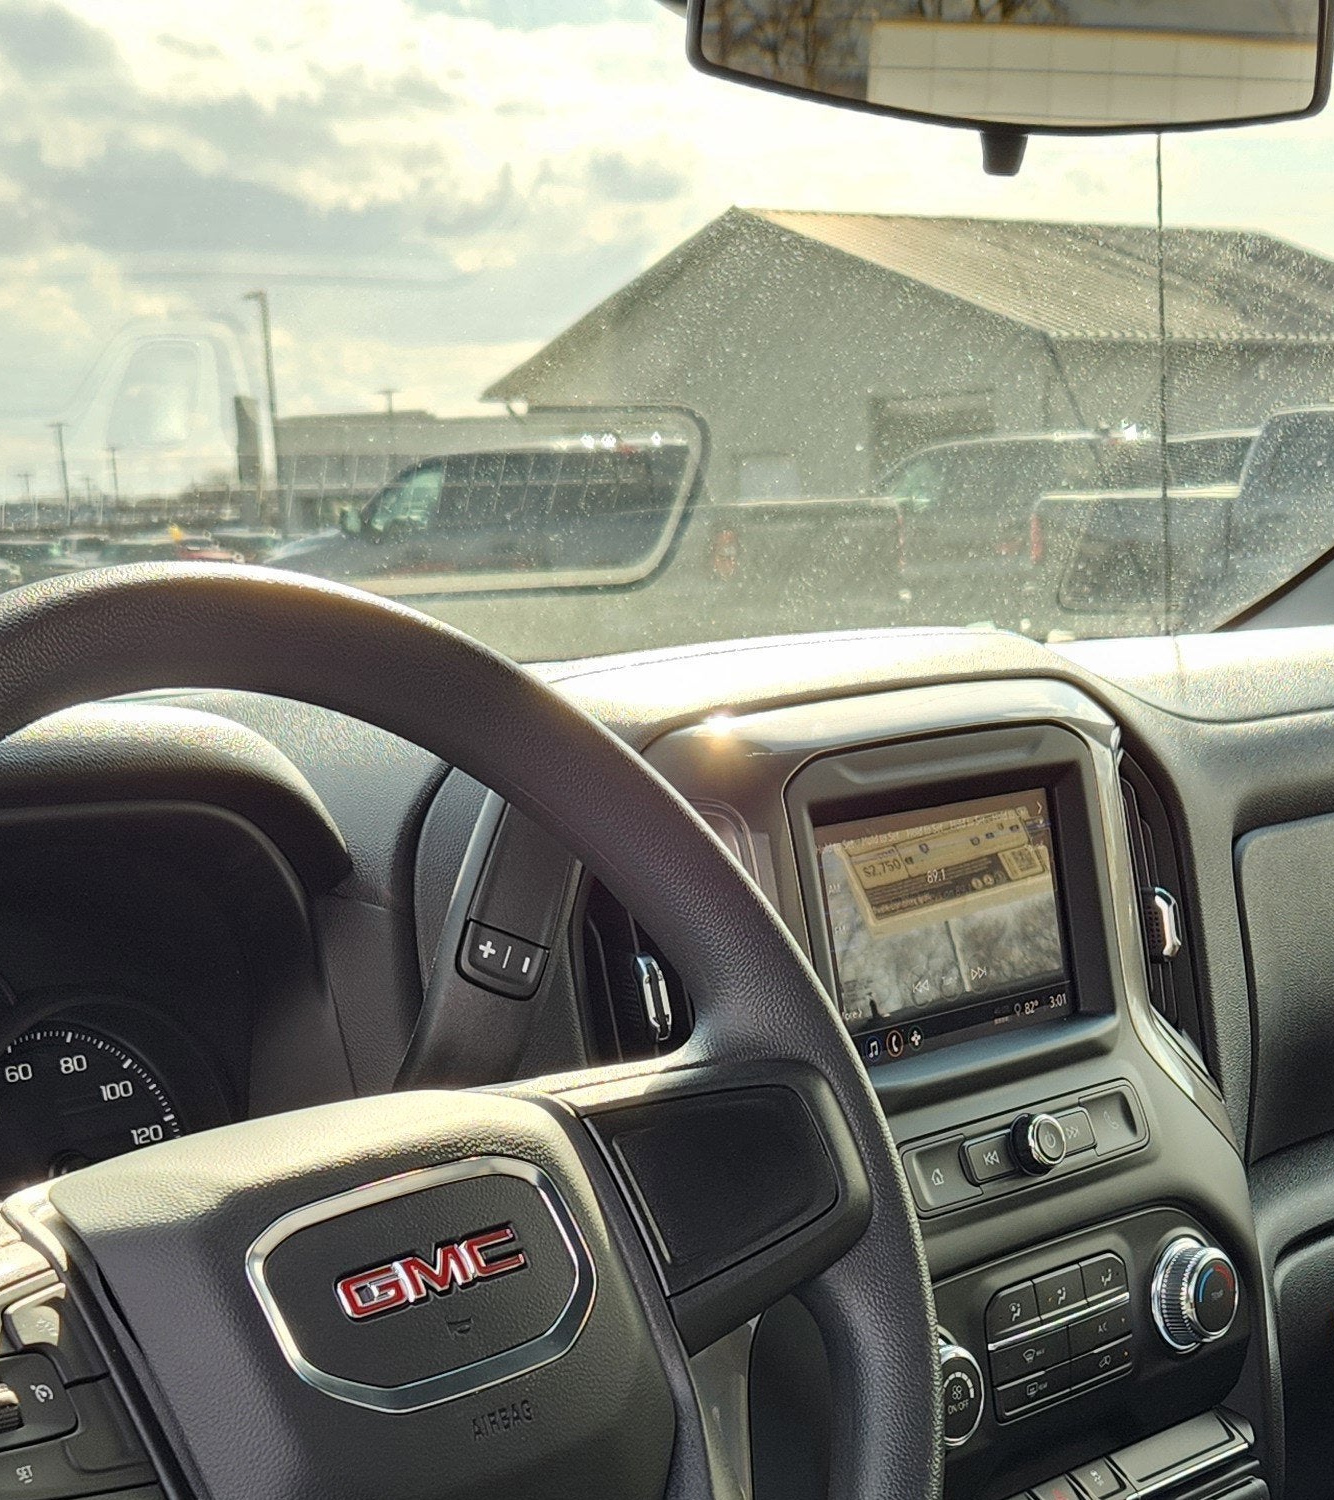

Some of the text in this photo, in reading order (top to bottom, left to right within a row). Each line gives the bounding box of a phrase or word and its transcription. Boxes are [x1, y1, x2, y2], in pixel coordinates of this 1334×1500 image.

[863, 859, 901, 878] $2,750
[926, 868, 946, 884] 89.1
[1049, 993, 1067, 1008] 3:01
[4, 1063, 33, 1083] 60
[60, 1055, 87, 1074] 80
[100, 1080, 133, 1101] 100
[131, 1124, 163, 1145] 120
[336, 1226, 526, 1319] GMC
[947, 1400, 969, 1415] ON/OFF
[471, 1400, 535, 1441] AIRBAG
